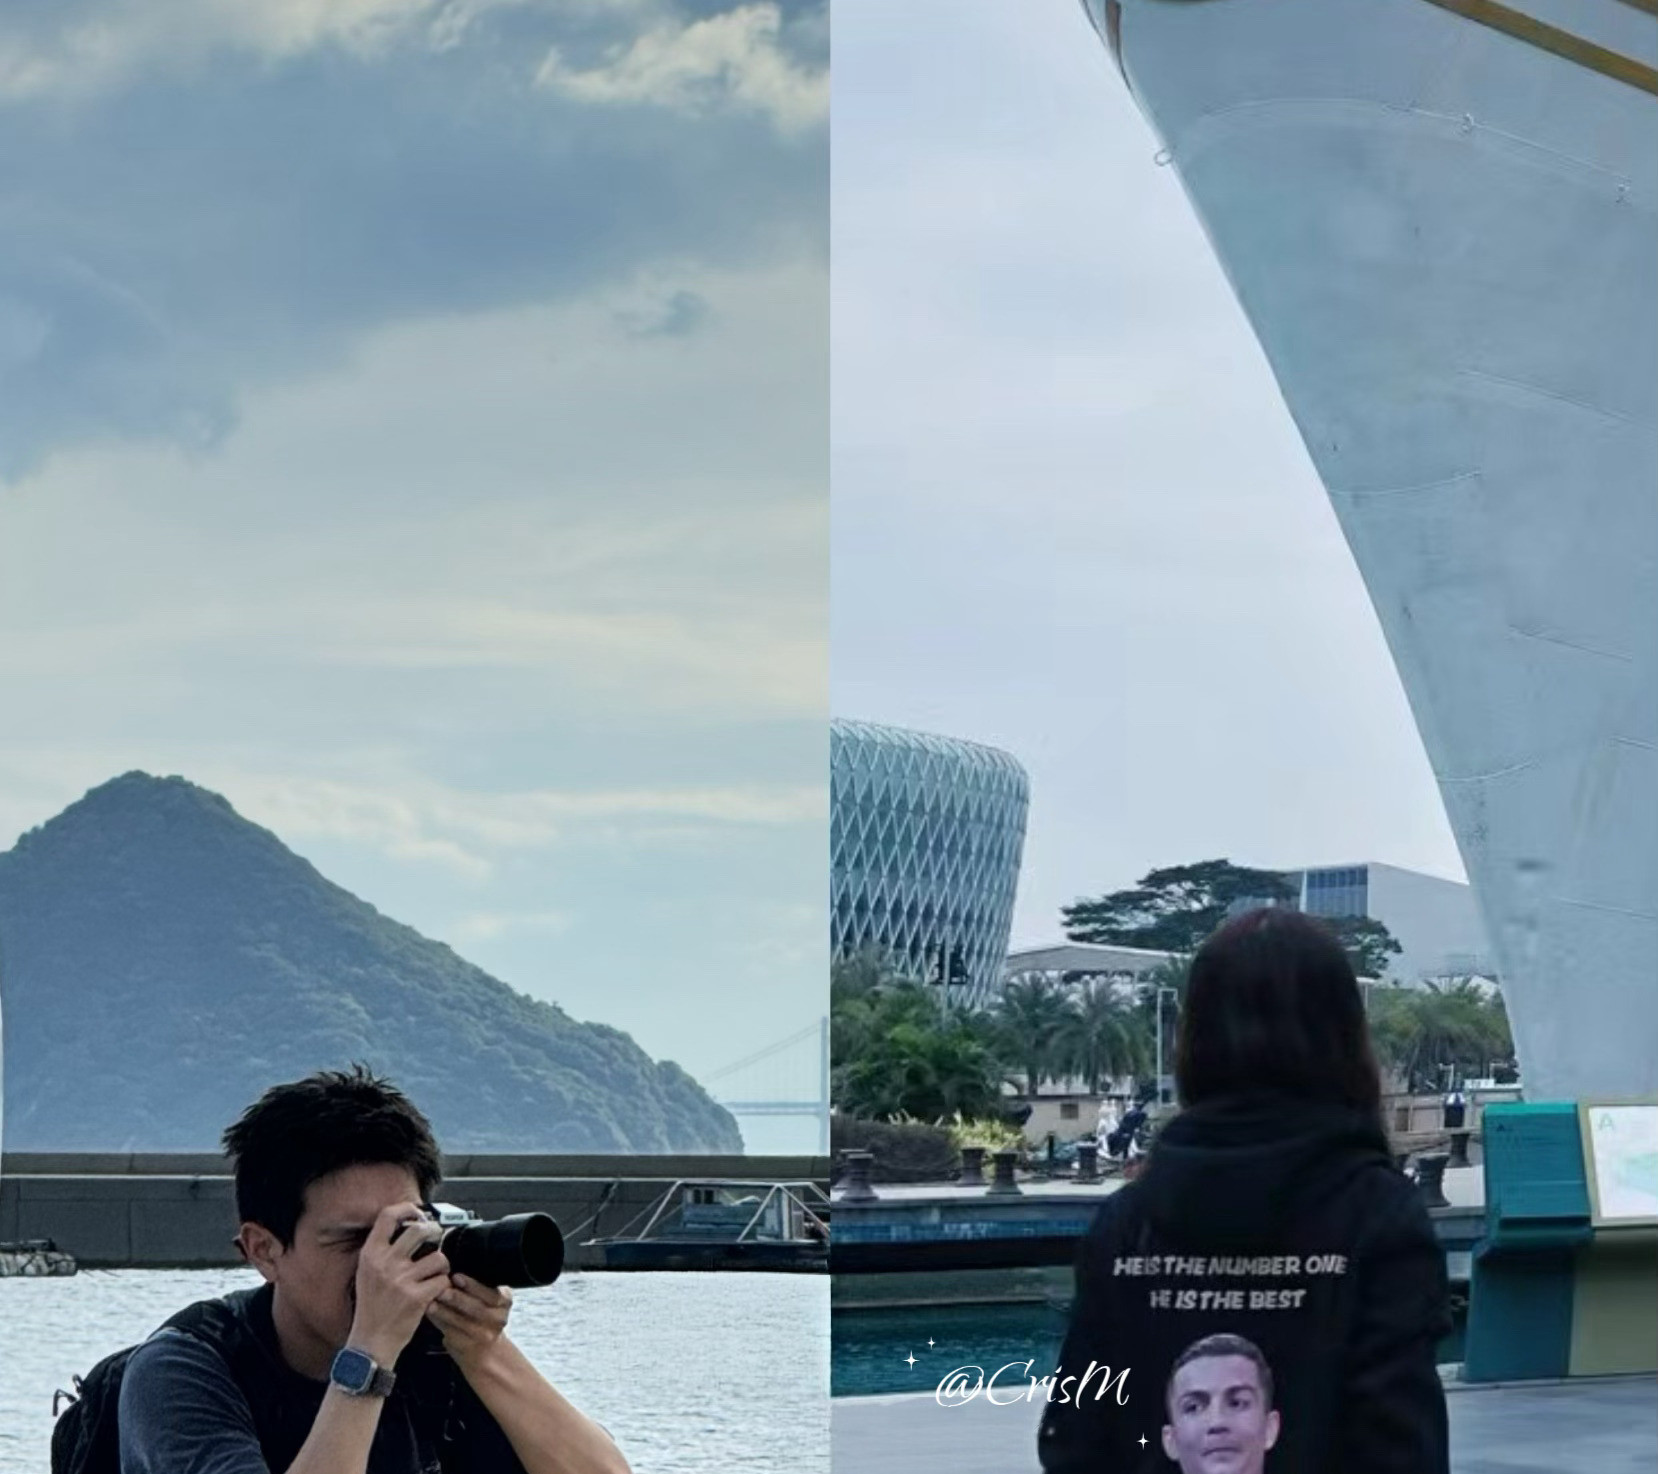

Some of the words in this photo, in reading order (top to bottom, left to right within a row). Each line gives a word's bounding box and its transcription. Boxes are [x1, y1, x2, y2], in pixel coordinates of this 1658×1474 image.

[1163, 1255, 1207, 1275] THE
[1207, 1257, 1300, 1275] NUMBER
[1304, 1255, 1348, 1274] ONE
[1150, 1290, 1172, 1308] HE
[1174, 1290, 1197, 1309] IS
[1199, 1291, 1245, 1310] THE
[1249, 1289, 1307, 1308] BEST
